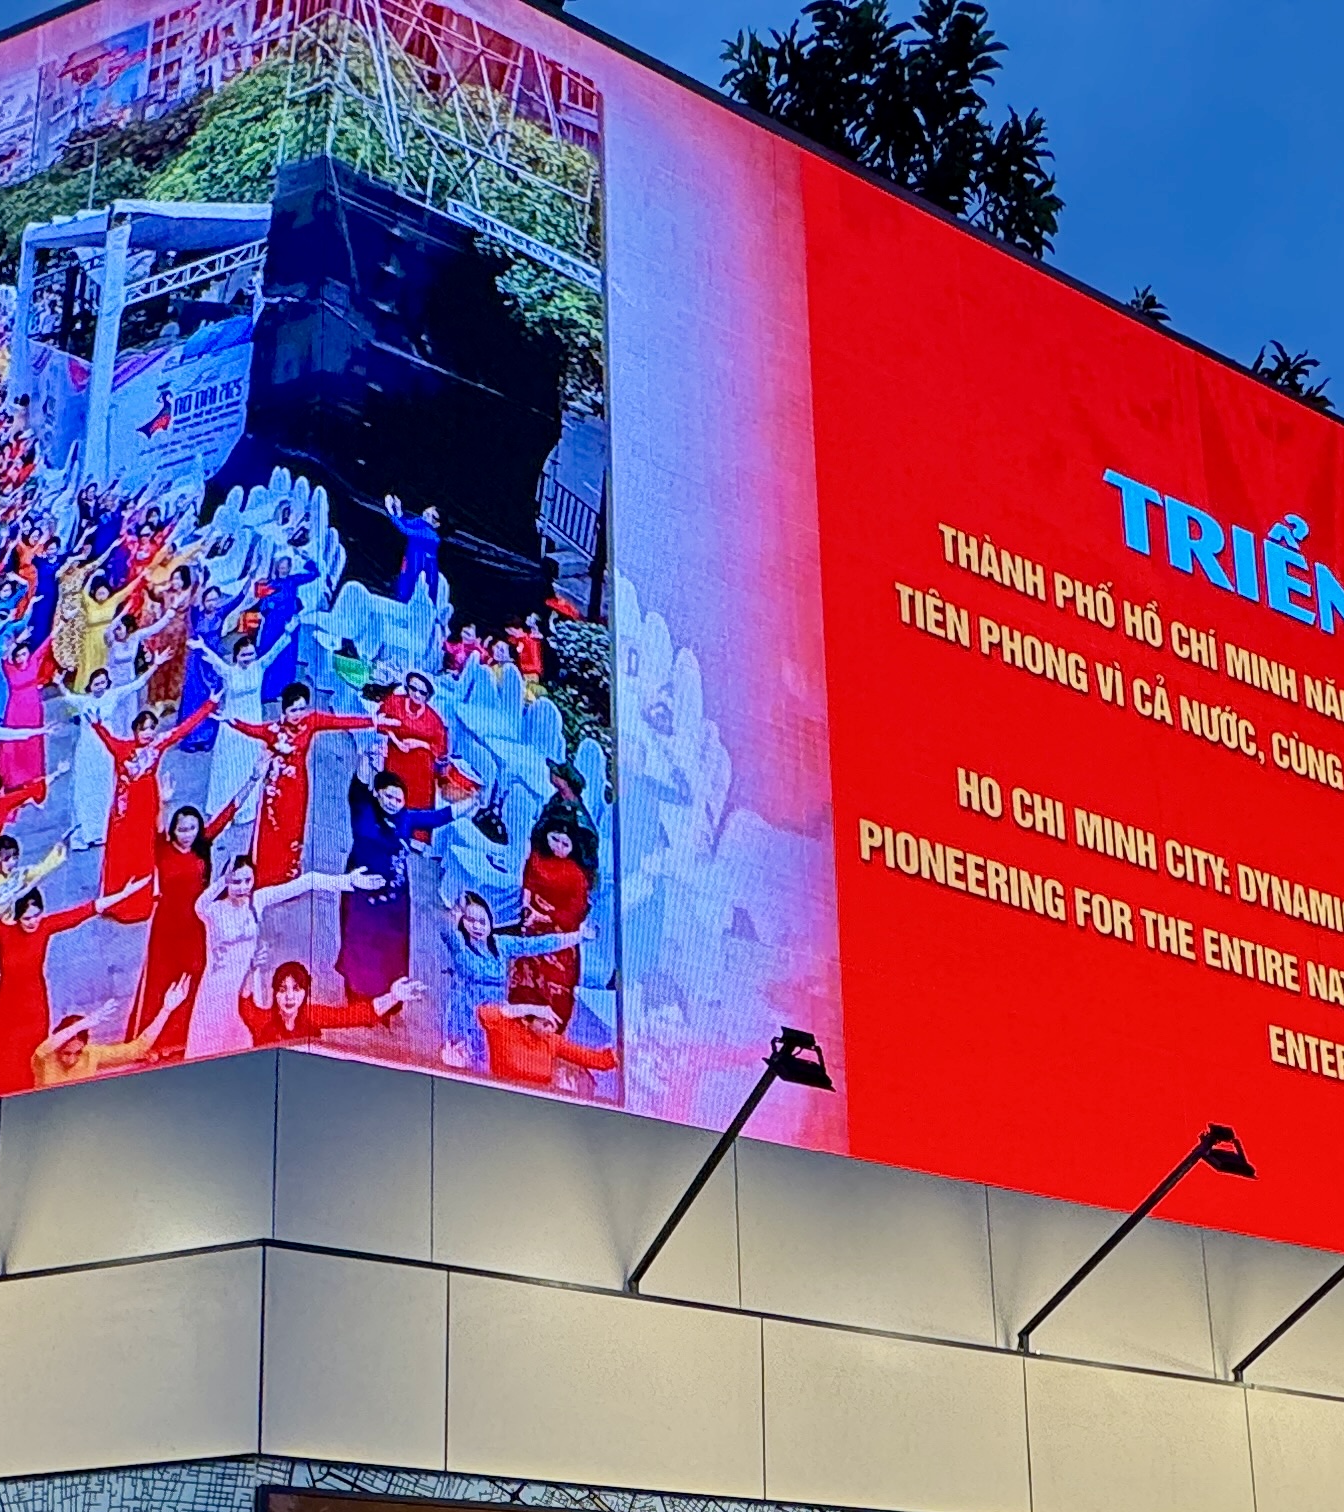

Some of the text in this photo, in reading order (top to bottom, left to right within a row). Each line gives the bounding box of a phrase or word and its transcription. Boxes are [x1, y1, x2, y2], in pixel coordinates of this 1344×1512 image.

[896, 583, 969, 647] TIÊN
[980, 617, 1088, 692] PHONG
[1096, 662, 1124, 706] VÌ
[1133, 675, 1172, 725] CẢ
[1180, 696, 1264, 764] NƯỚC,
[1272, 732, 1344, 790] CÙNG
[939, 523, 1045, 600] THÀNH
[1054, 573, 1115, 627] PHỐ
[1124, 601, 1162, 647] HỒ
[1171, 622, 1217, 670] CHÍ
[1225, 643, 1297, 702] MINH
[860, 819, 1065, 920] PIONEERING
[1075, 888, 1133, 941] FOR
[1140, 909, 1195, 960] THE
[1204, 928, 1300, 991] ENTIRE
[958, 768, 1002, 817] HO
[1013, 788, 1065, 839] CHI
[1075, 808, 1157, 870] MINH
[1166, 840, 1230, 894] CITY:
